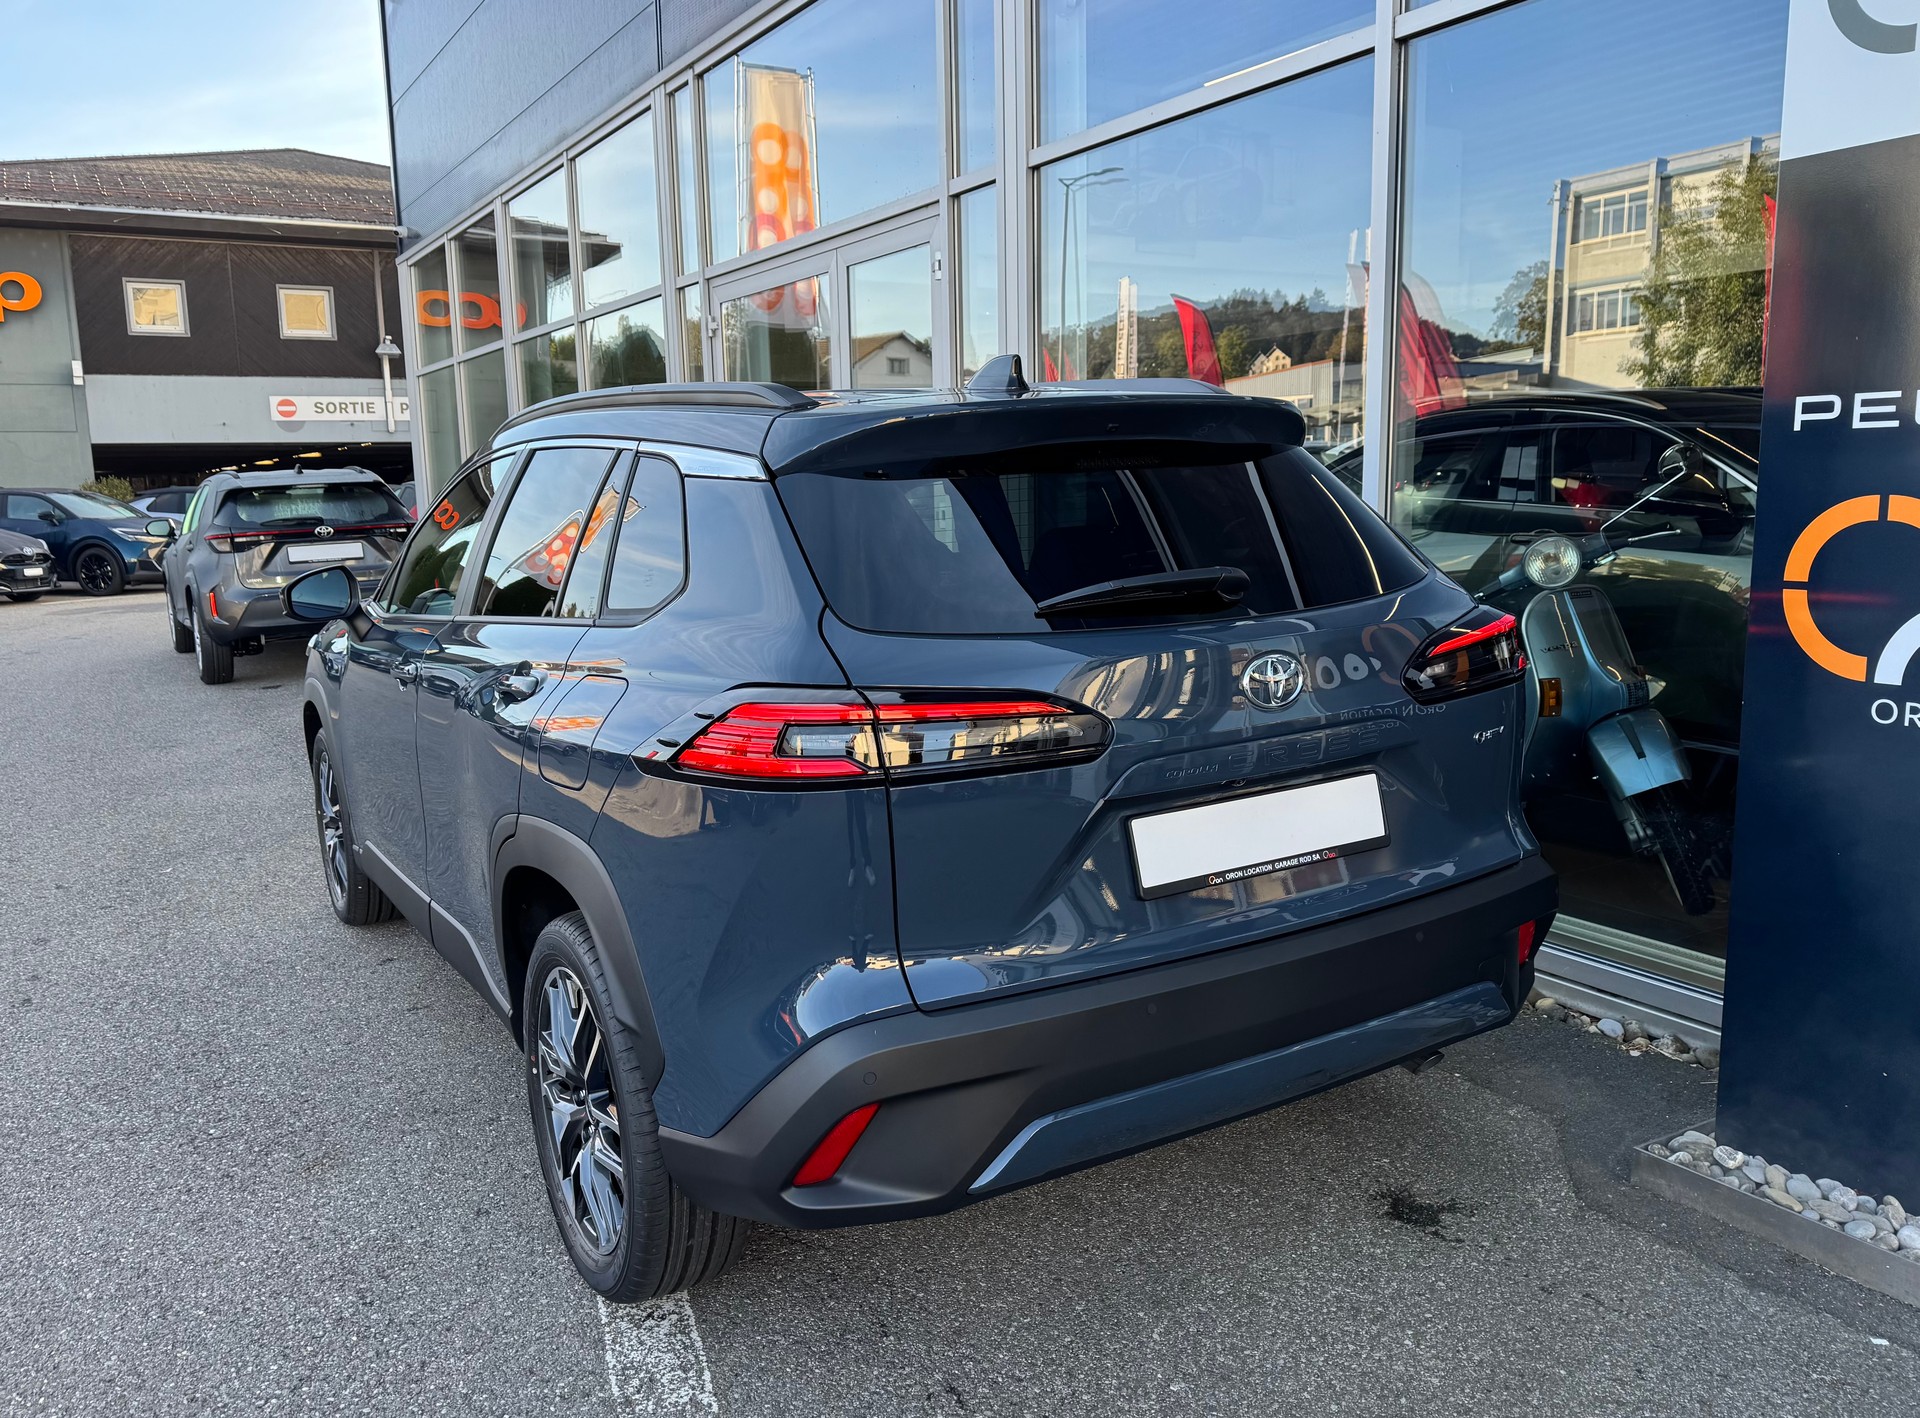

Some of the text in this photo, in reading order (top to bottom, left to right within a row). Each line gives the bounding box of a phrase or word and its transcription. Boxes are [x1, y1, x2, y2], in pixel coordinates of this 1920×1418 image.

[314, 401, 376, 414] SORTIE
[1793, 390, 1920, 432] PE
[1225, 870, 1243, 880] ORON
[1243, 863, 1273, 876] LOCATION
[1274, 858, 1299, 869] GARAGE
[1299, 855, 1312, 864] ROD
[1312, 853, 1321, 861] SA
